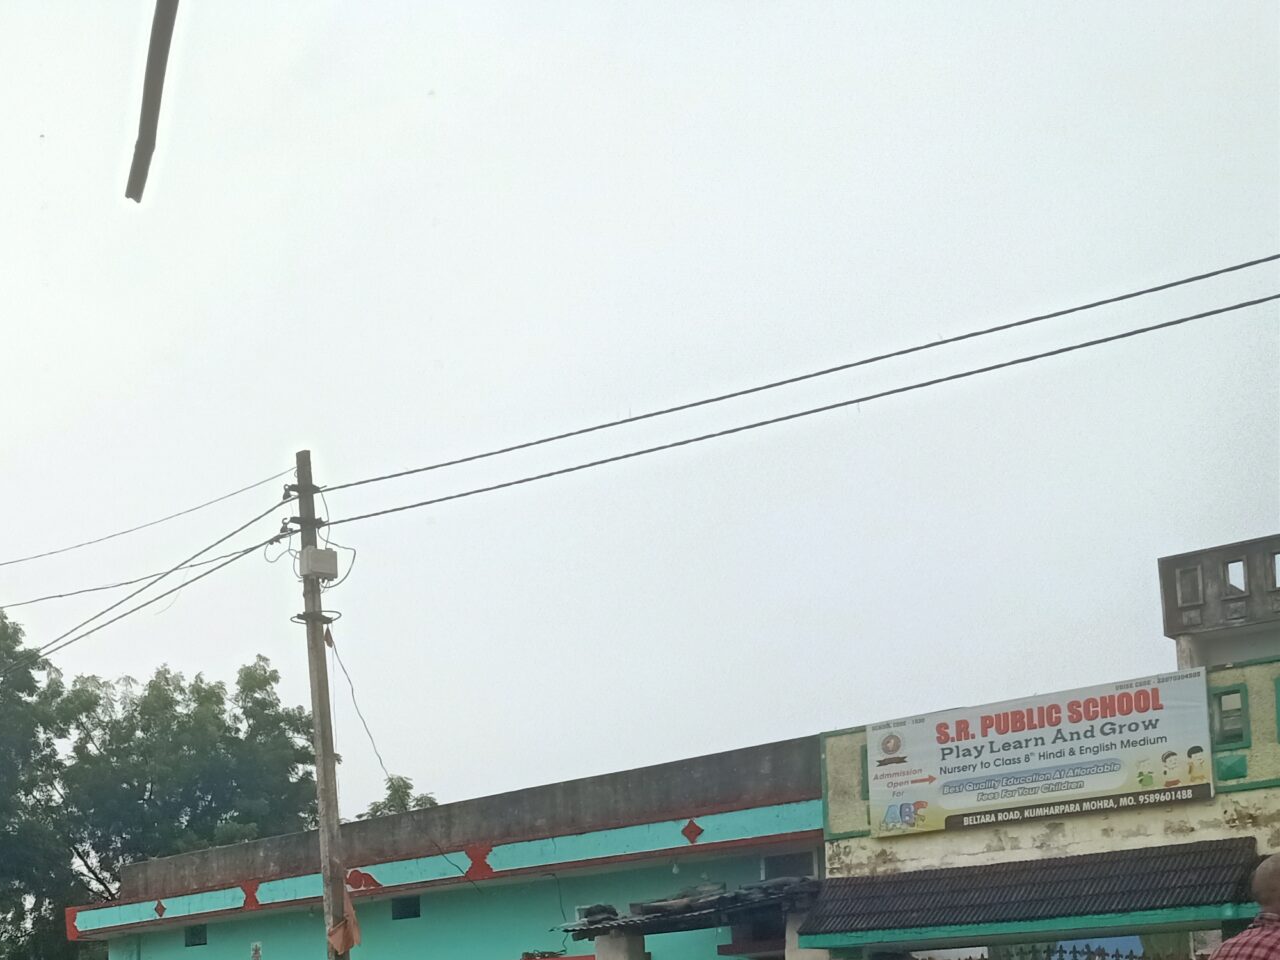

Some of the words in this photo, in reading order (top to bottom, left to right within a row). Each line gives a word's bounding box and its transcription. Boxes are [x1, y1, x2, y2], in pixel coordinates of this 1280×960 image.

[936, 720, 975, 744] S.R.
[980, 704, 1062, 738] PUBLIC
[1067, 687, 1164, 724] SCHOOL
[939, 763, 977, 776] Nursery
[980, 759, 990, 769] to
[993, 756, 1021, 767] Class
[1038, 747, 1065, 760] Hindi
[1069, 747, 1076, 757] &
[1079, 741, 1117, 757] English
[1120, 735, 1168, 751] Medium
[940, 744, 984, 761] Play
[989, 735, 1045, 754] Learn
[1052, 725, 1095, 744] And
[1100, 718, 1160, 737] Grow
[886, 779, 910, 789] Open
[892, 789, 905, 798] For
[943, 782, 964, 795] Best
[965, 778, 1000, 793] Quality
[1001, 770, 1051, 787] Education
[1052, 768, 1065, 780] At
[1067, 762, 1120, 777] Affordable
[976, 791, 999, 802] Fees
[1001, 789, 1017, 799] For
[1018, 786, 1039, 797] Your
[1041, 781, 1085, 794] Children
[963, 812, 996, 826] BELTARA
[998, 810, 1022, 823] ROAD,
[1024, 805, 1080, 819] KUMHARPARA
[1082, 800, 1117, 812] MOHRA,
[1119, 796, 1136, 807] MO.
[1138, 789, 1193, 804] 9589601488
